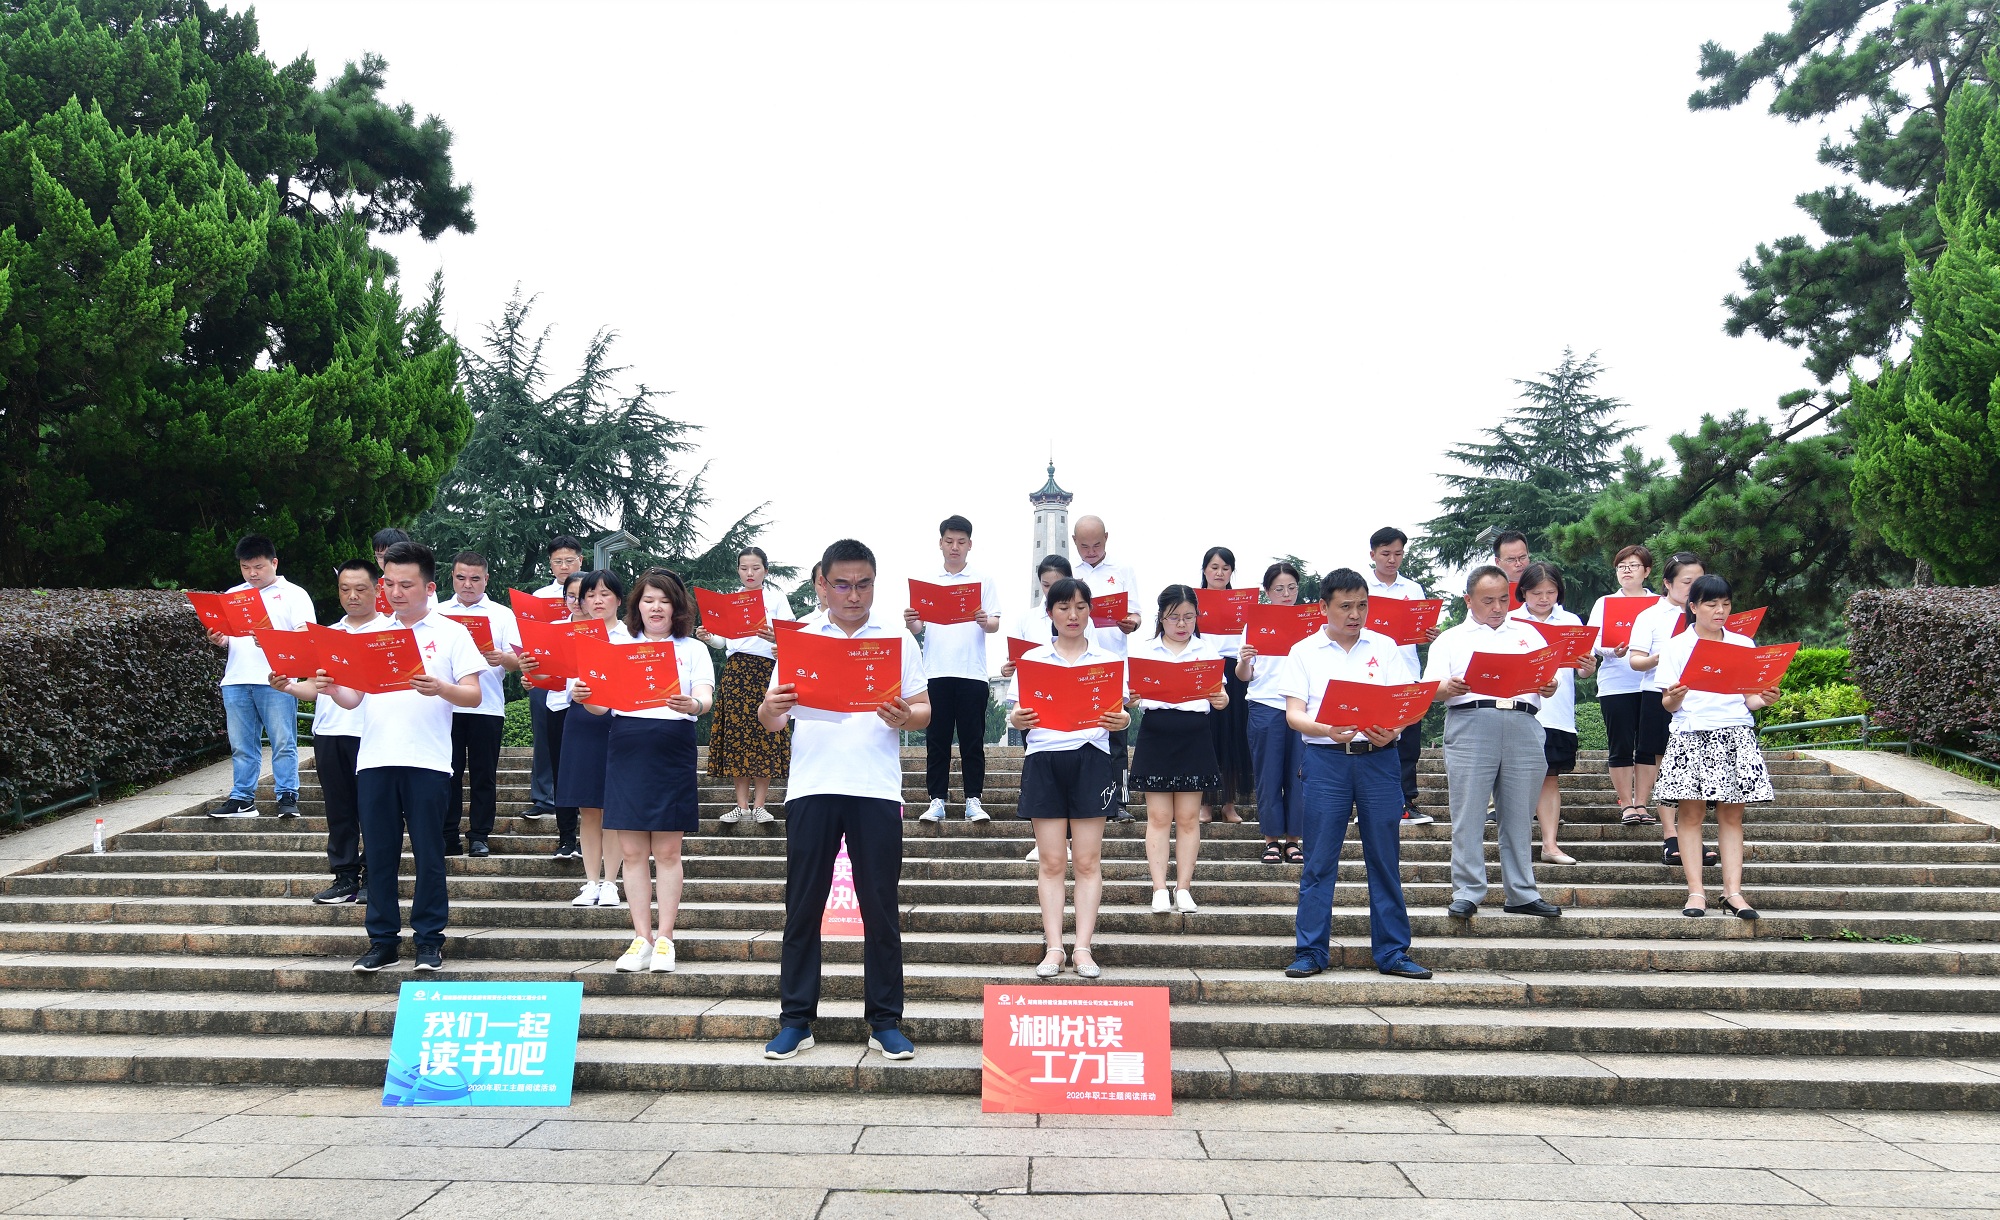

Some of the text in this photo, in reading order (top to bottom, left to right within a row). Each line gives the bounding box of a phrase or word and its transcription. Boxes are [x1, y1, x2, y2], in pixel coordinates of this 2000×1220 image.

[421, 1011, 552, 1039] 我们一起
[1009, 1014, 1123, 1048] 湘悦读
[418, 1041, 548, 1076] 读书吧
[1030, 1050, 1146, 1085] 工力量
[467, 1083, 557, 1093] 2020年职工主题阅读活动
[1066, 1091, 1157, 1101] 2020年职工主题阅读活动
